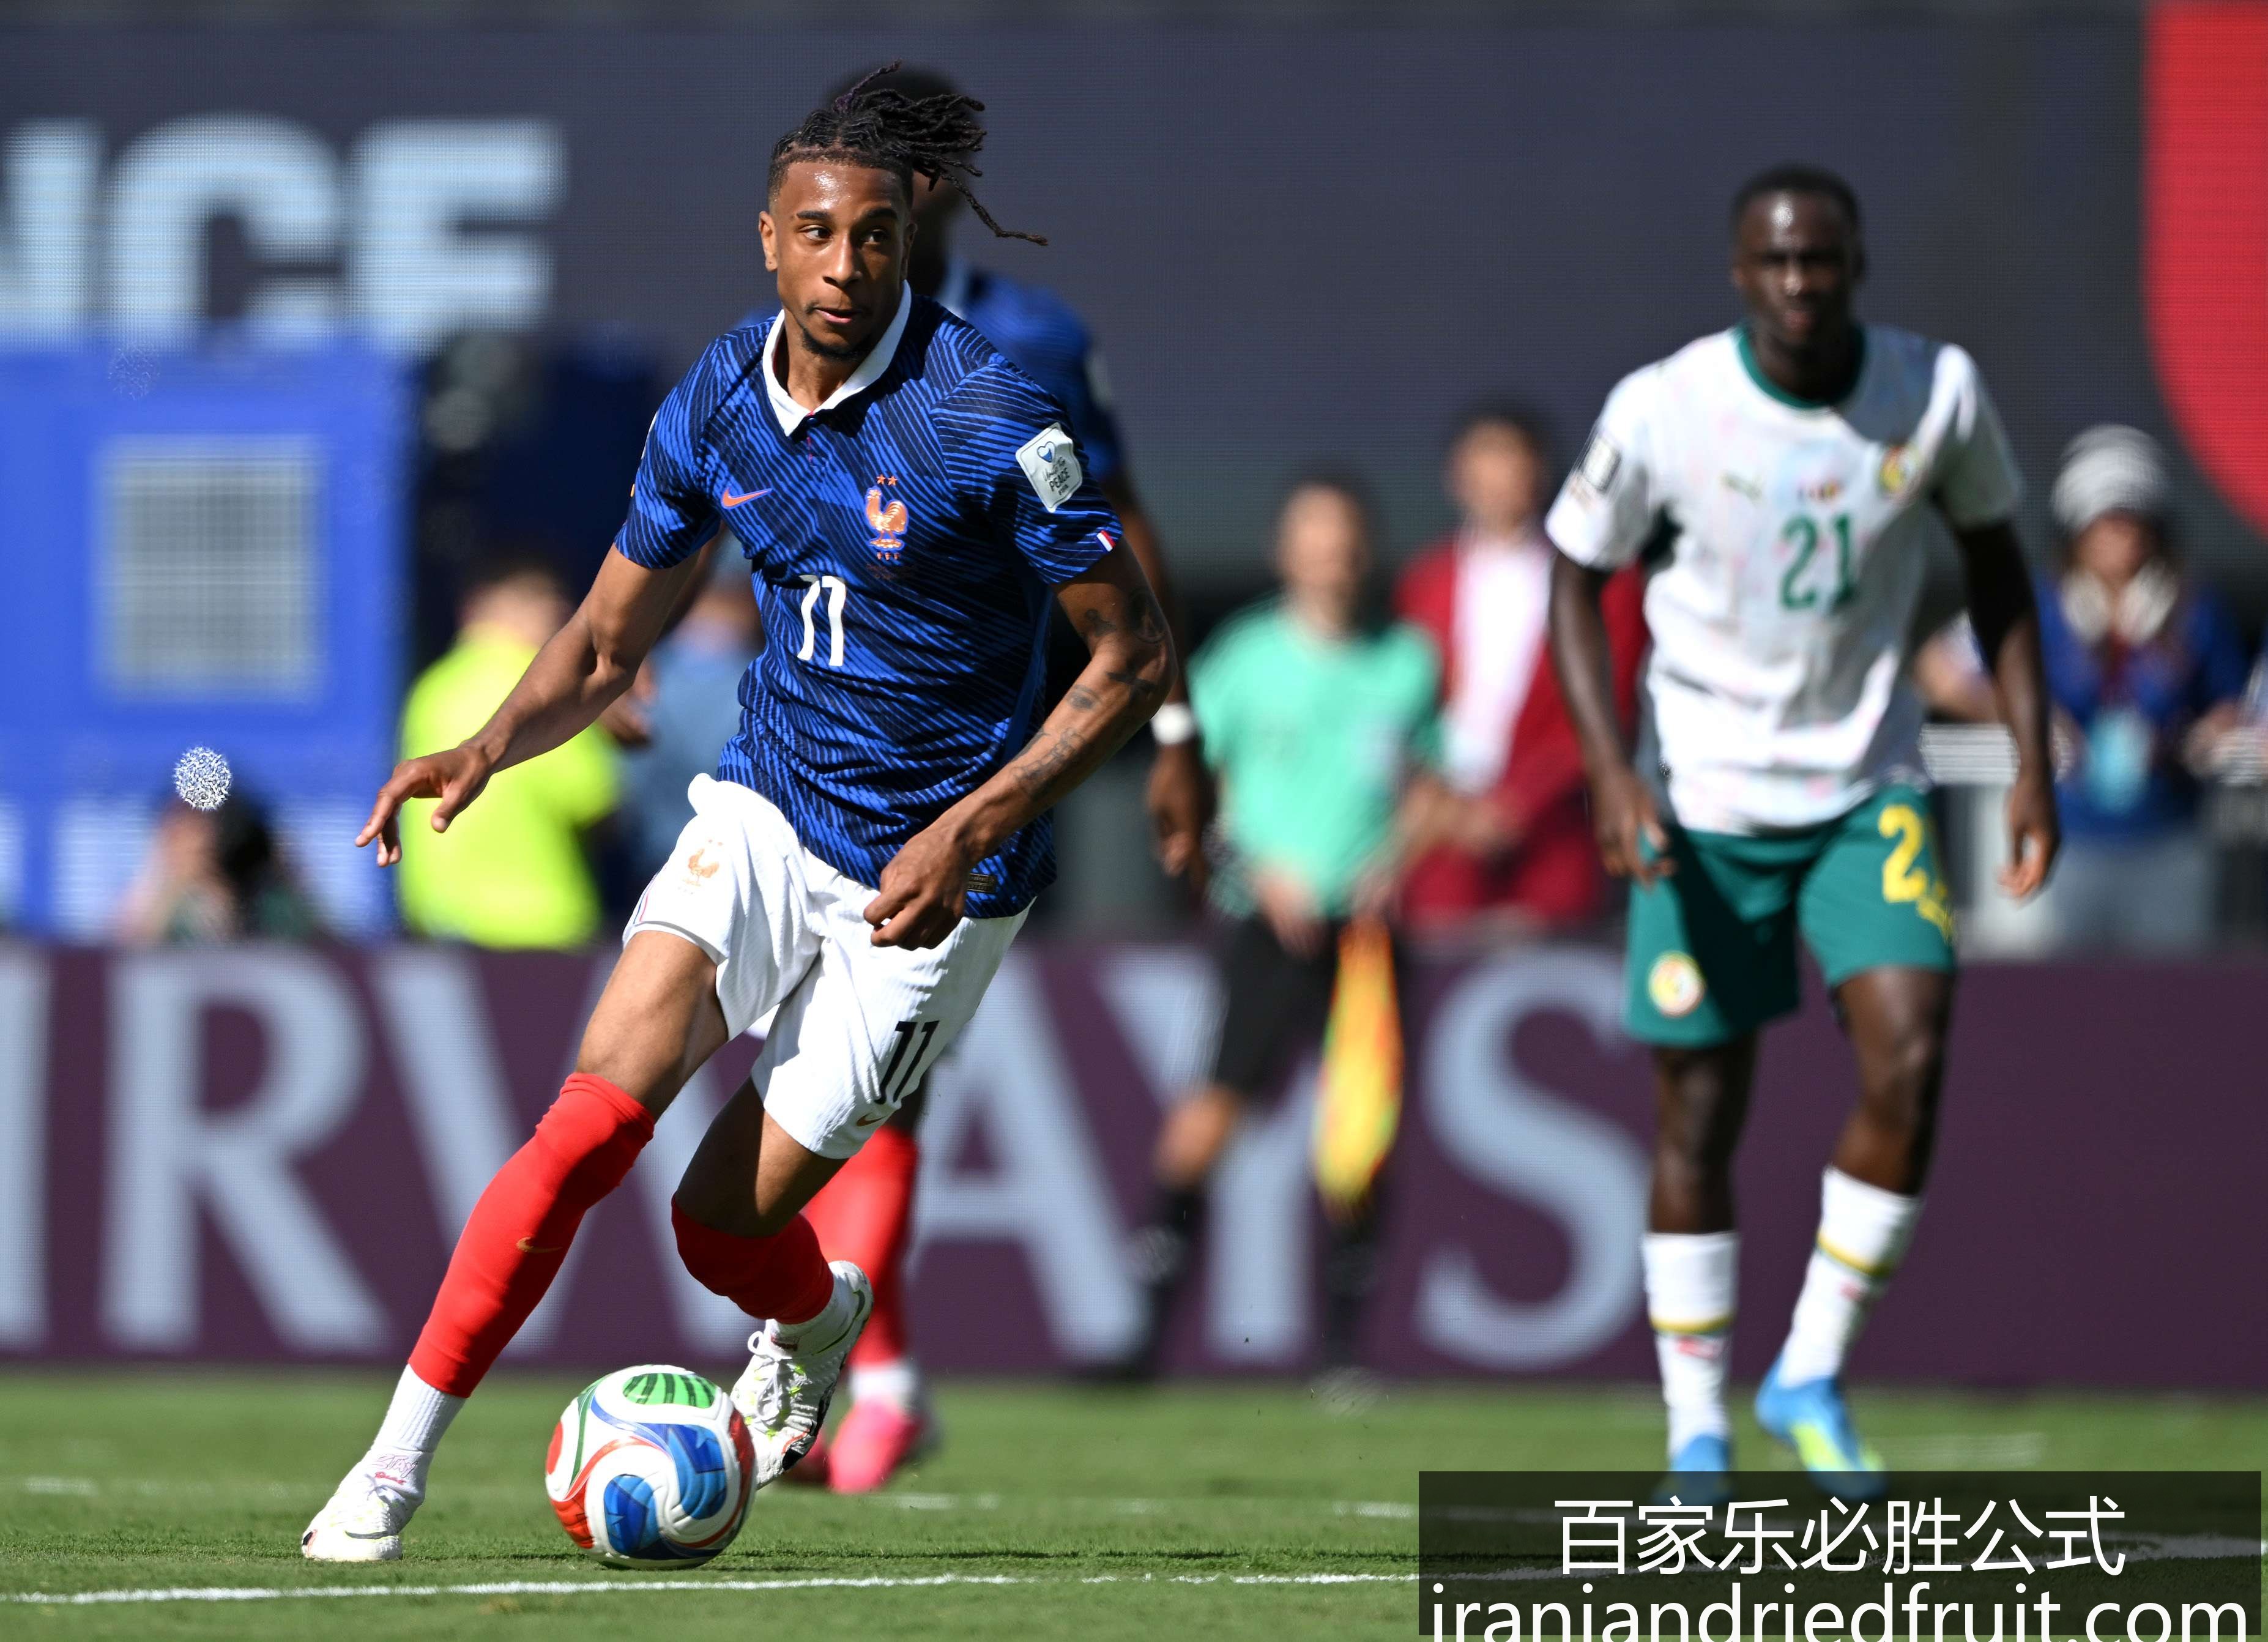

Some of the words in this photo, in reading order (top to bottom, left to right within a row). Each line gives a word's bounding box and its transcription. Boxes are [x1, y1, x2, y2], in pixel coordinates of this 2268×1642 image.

[1781, 513, 1853, 609] 21
[797, 574, 847, 667] 11
[874, 1020, 940, 1105] 11
